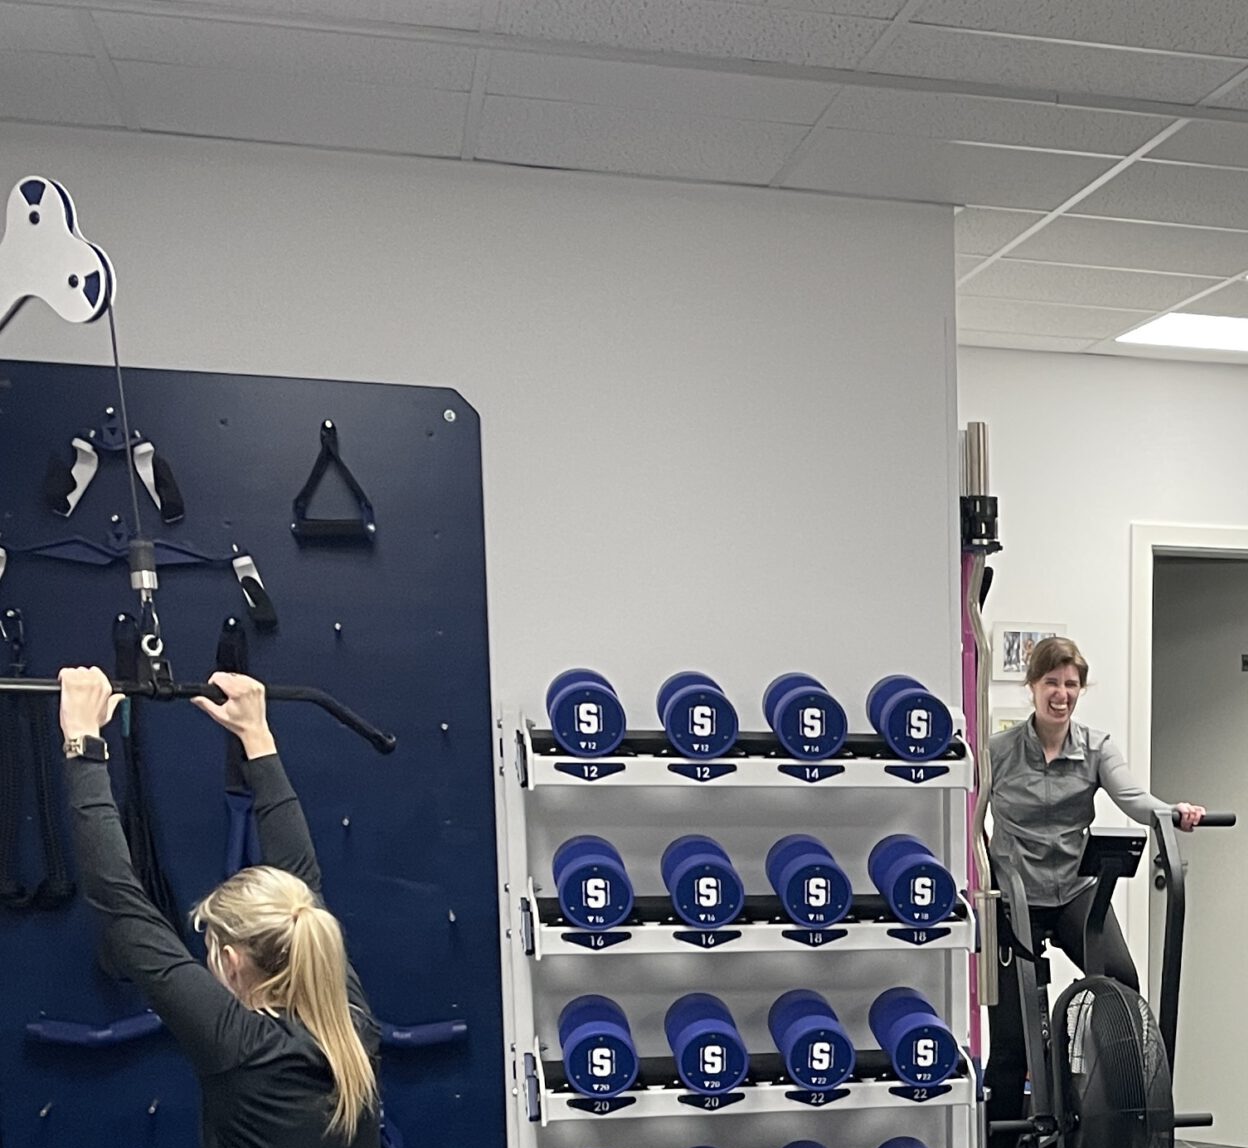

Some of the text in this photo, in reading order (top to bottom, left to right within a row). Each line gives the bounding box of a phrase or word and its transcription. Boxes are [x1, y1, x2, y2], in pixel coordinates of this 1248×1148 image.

[579, 703, 598, 734] S
[693, 706, 712, 736] S
[803, 708, 821, 738] S
[910, 709, 928, 739] S
[583, 766, 598, 777] 12
[696, 767, 710, 778] 12
[805, 768, 819, 779] 14
[911, 769, 924, 780] 14
[587, 878, 605, 908] S
[699, 877, 718, 907] S
[809, 877, 826, 907] S
[914, 877, 932, 906] S
[590, 935, 604, 946] 16
[701, 934, 715, 945] 16
[809, 932, 822, 943] 18
[913, 931, 926, 942] 18
[592, 1048, 611, 1077] S
[704, 1045, 722, 1074] S
[812, 1042, 830, 1070] S
[917, 1039, 934, 1067] S
[704, 1097, 719, 1107] 20
[811, 1093, 825, 1103] 22
[913, 1089, 927, 1099] 22
[594, 1101, 610, 1112] 20
